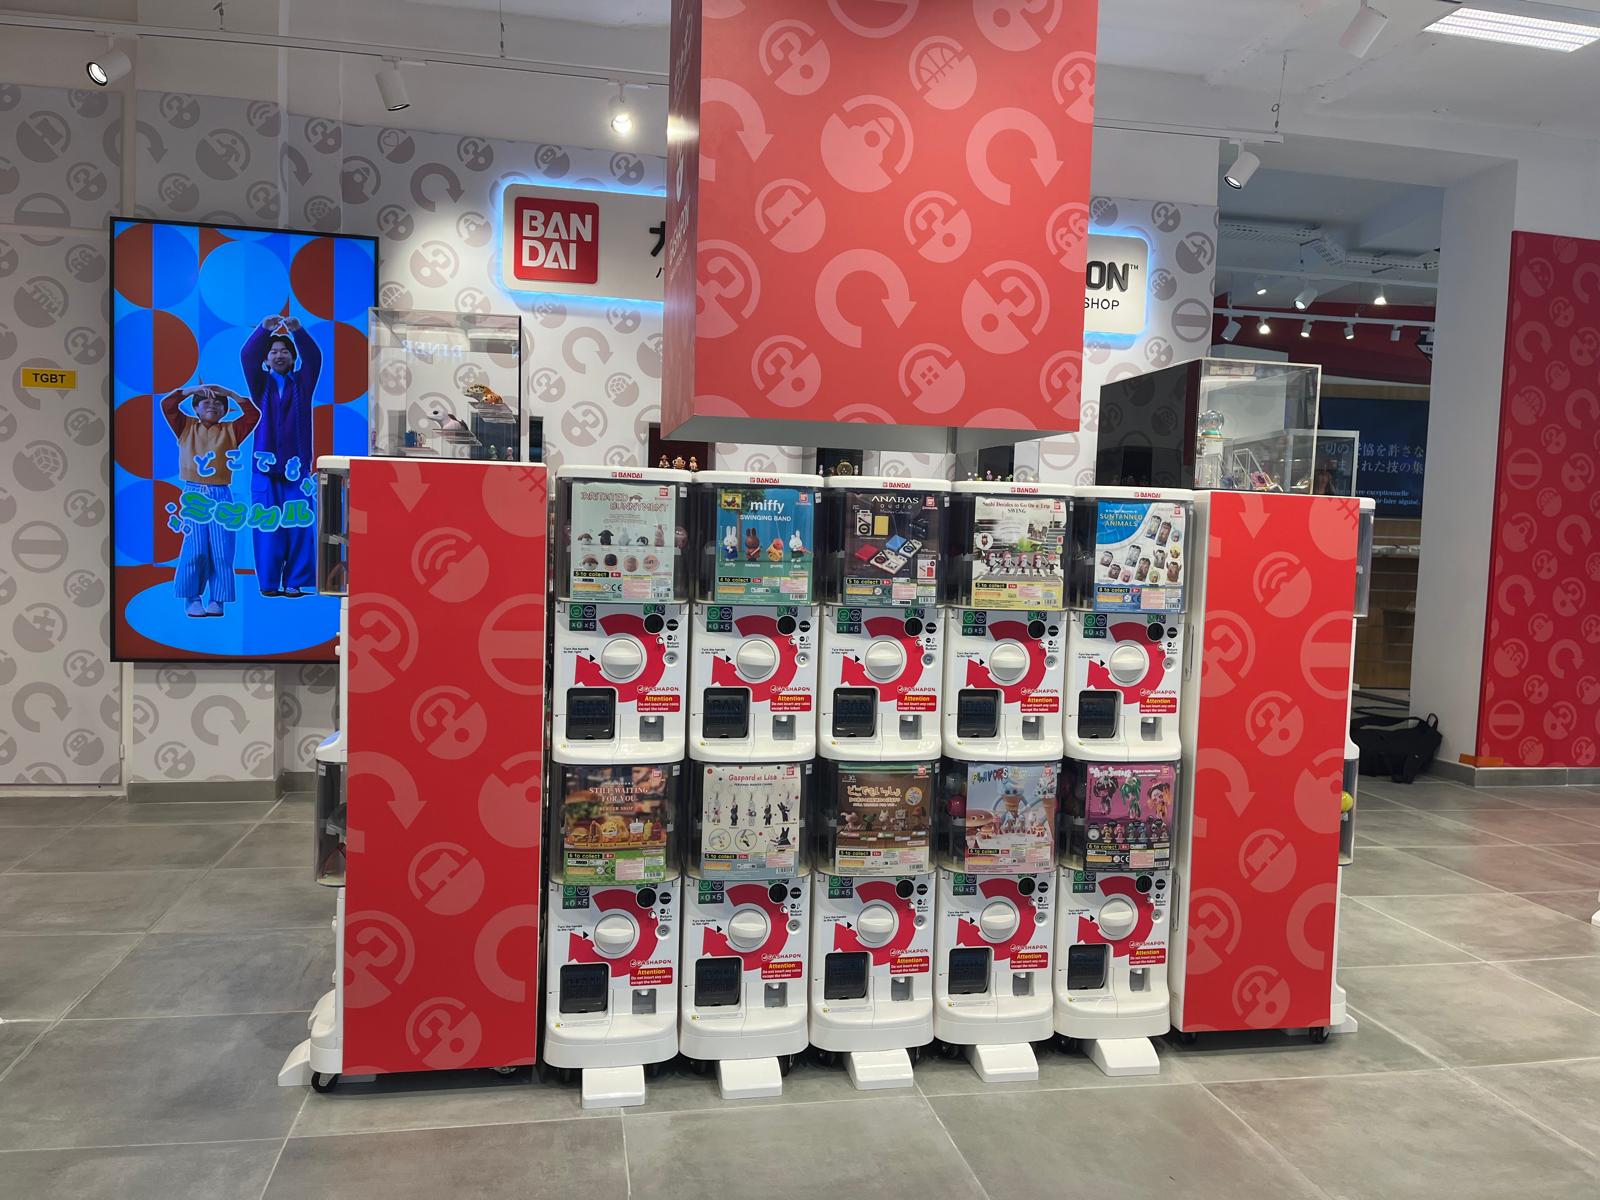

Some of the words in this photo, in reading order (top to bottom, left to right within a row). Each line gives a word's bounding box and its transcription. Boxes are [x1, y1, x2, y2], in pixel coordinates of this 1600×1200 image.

[522, 209, 592, 241] BAN
[522, 239, 577, 270] DAI
[1084, 297, 1119, 310] SHOP
[32, 372, 66, 384] TGBT
[193, 450, 302, 481] どこでも
[750, 500, 785, 513] miffy
[871, 496, 919, 504] ANABAS
[1099, 513, 1143, 521] SUNTANNED
[728, 774, 755, 782] Gaspard
